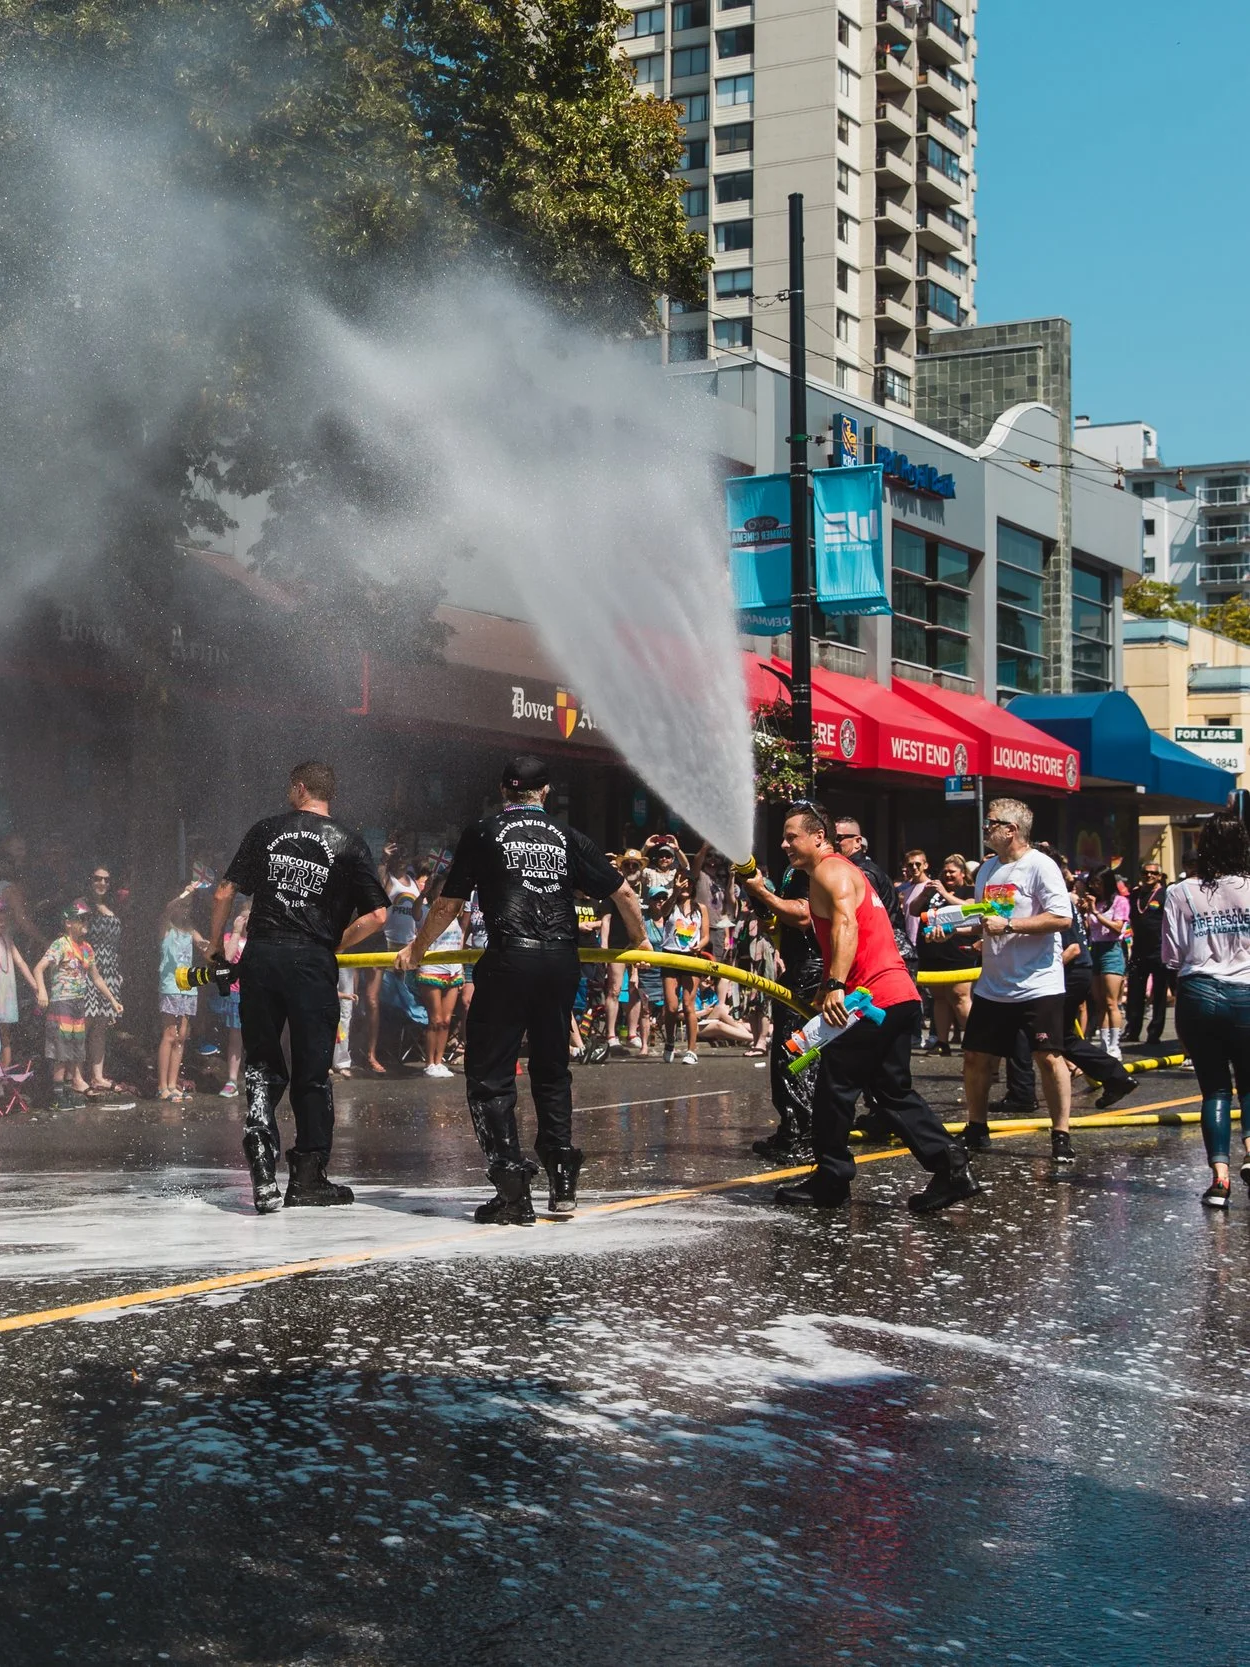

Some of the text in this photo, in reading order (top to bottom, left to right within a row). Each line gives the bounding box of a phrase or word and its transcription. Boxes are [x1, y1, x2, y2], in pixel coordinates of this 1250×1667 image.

[512, 686, 554, 721] Dover
[1176, 730, 1236, 740] FOR LEASE
[891, 737, 950, 767] WEST END
[993, 746, 1064, 778] LIQUOR STORE
[267, 831, 300, 851] Serving
[300, 831, 321, 842] With
[495, 820, 524, 843] Serving
[523, 819, 546, 829] With
[502, 841, 566, 857] VANCOUVER
[269, 853, 330, 876] VANCOUVER
[503, 849, 567, 876] FIRE
[268, 861, 328, 895] FIRE
[521, 869, 559, 880] LOCAL 18
[522, 879, 543, 894] Since
[1192, 914, 1250, 931] FIRE RESCUE
